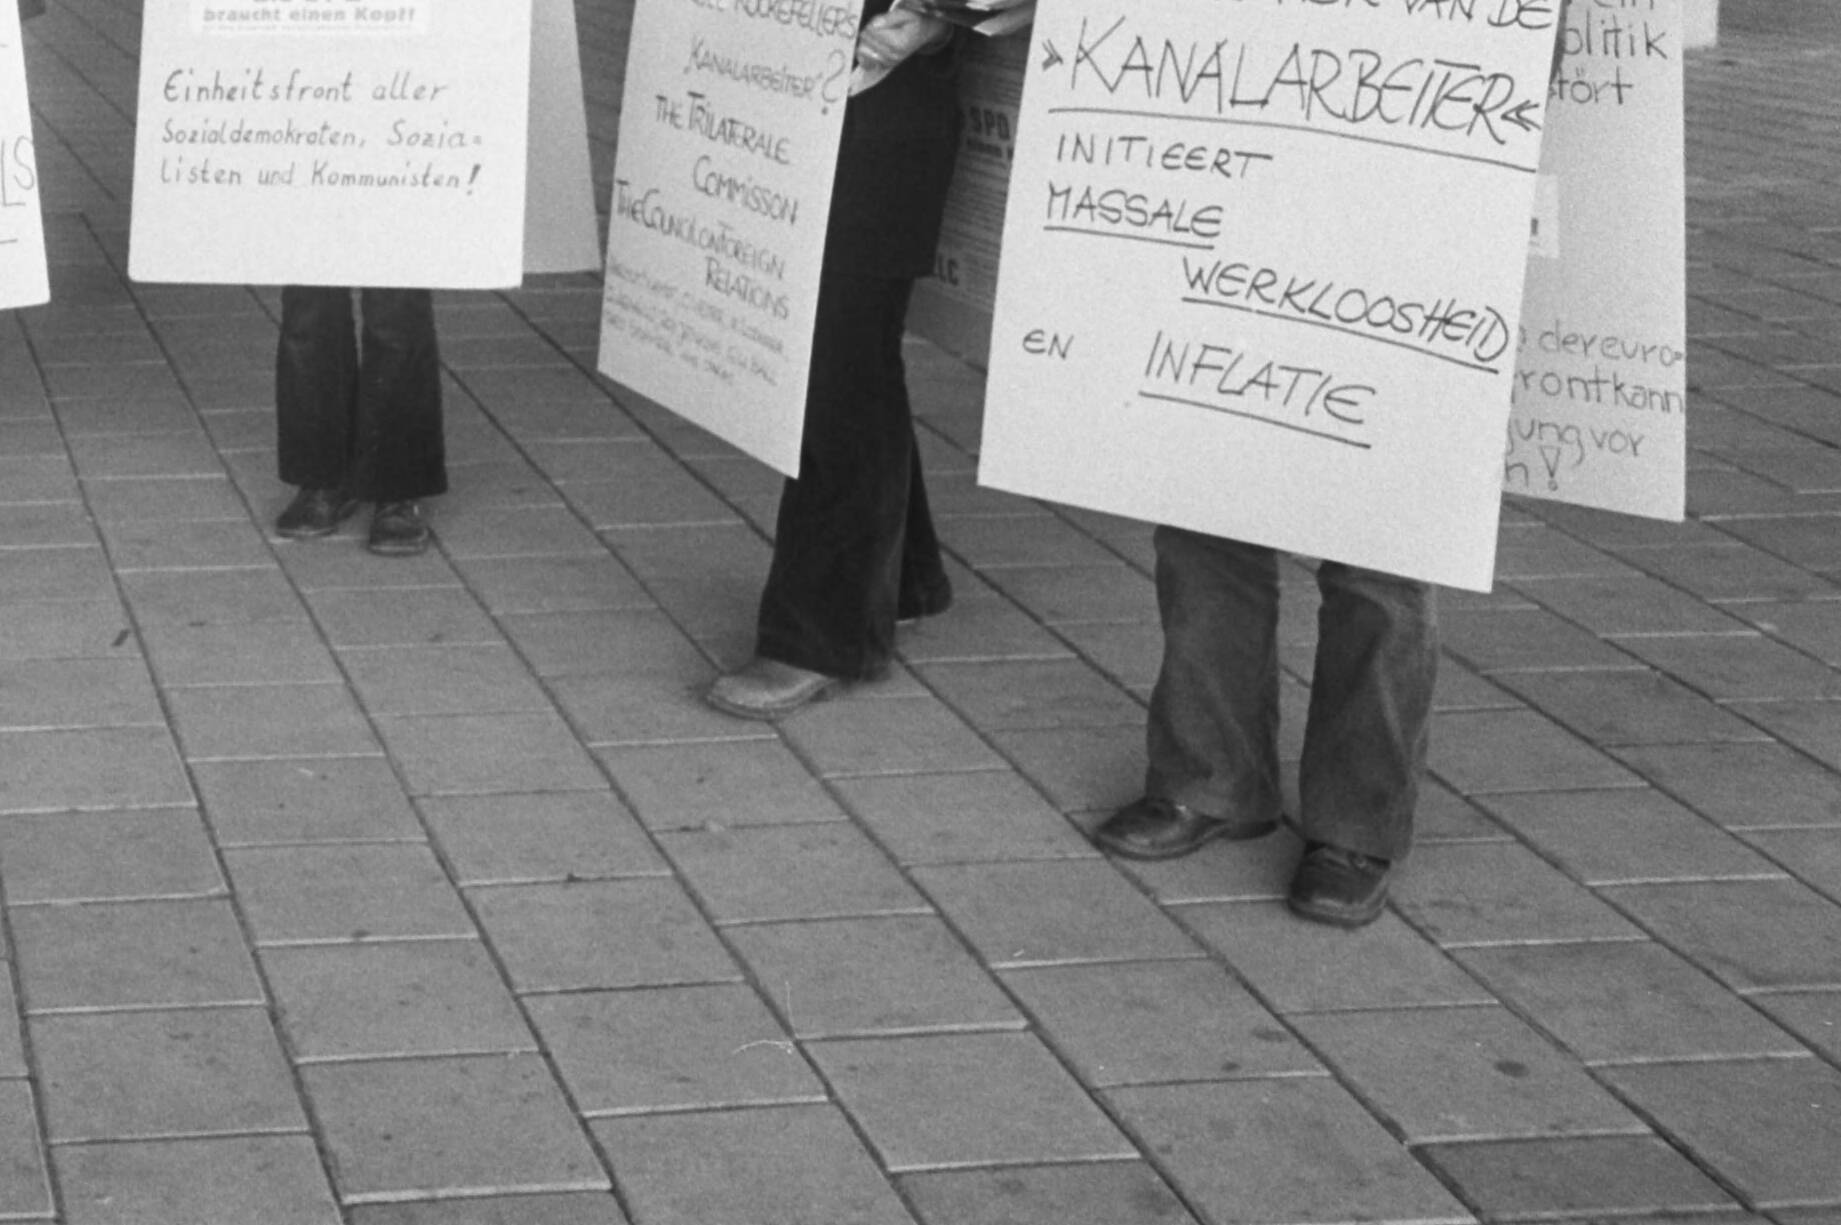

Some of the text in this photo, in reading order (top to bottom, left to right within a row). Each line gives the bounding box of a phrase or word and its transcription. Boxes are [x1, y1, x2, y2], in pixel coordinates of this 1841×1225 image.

[203, 8, 280, 22] braucht
[289, 8, 346, 22] einen
[163, 68, 449, 103] Einheitsfront aller
[656, 94, 684, 131] THE
[258, 161, 295, 186] und
[1058, 133, 1274, 178] INITIEERT
[1046, 181, 1224, 237] MASSALE
[1182, 255, 1510, 363] WERKLOOSHEID
[1023, 328, 1376, 425] EN INFLATIE
[1590, 427, 1645, 458] vor
